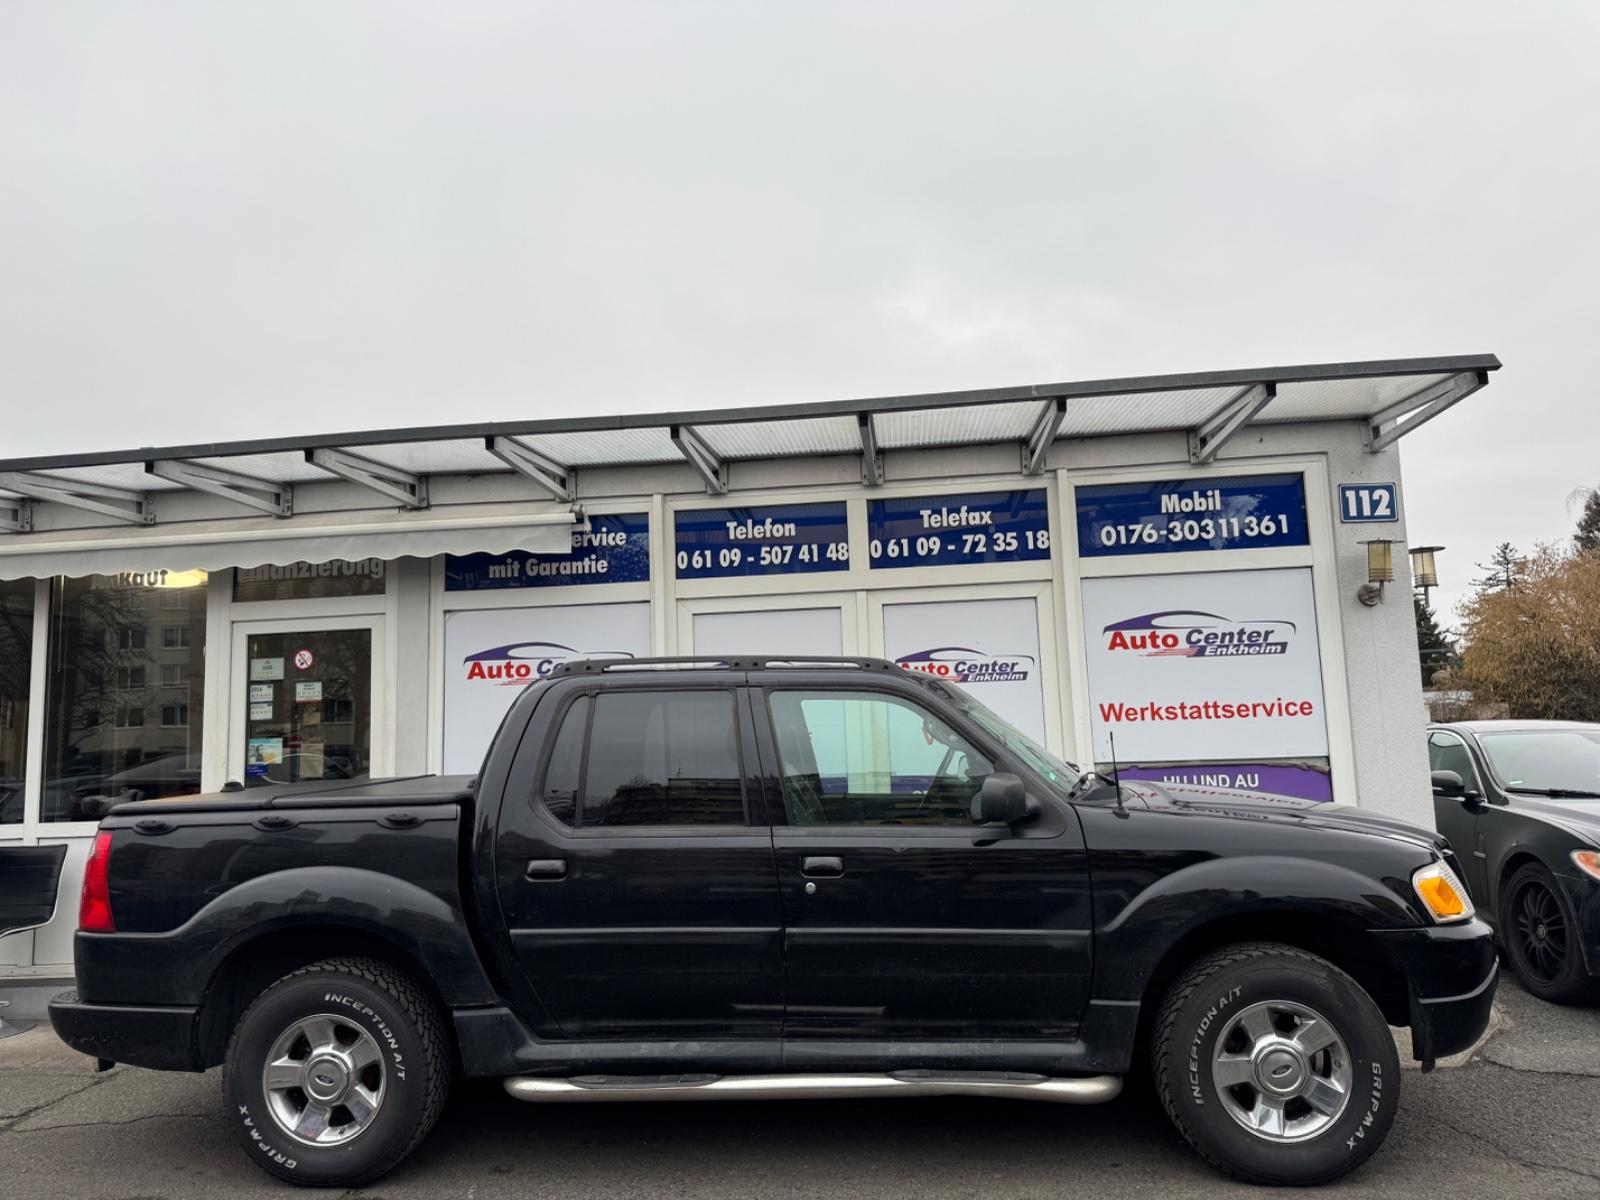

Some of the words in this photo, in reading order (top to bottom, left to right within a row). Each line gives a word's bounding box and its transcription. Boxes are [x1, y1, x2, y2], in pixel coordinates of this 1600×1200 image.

[1161, 489, 1221, 514] Mobil
[1344, 489, 1391, 517] 112
[920, 505, 992, 528] Telefax
[571, 527, 627, 548] ervice
[726, 518, 796, 540] Telefon
[677, 551, 688, 569] 0
[692, 550, 712, 569] 61
[719, 548, 741, 567] 09
[760, 545, 793, 566] 507
[799, 544, 819, 563] 41
[826, 542, 848, 561] 48
[870, 539, 882, 559] 0
[887, 538, 909, 558] 61
[916, 536, 941, 556] 09
[962, 533, 987, 553] 72
[993, 531, 1018, 551] 35
[1025, 530, 1050, 550] 18
[488, 558, 520, 579] mit
[525, 555, 608, 577] Garantie
[1108, 629, 1179, 651] Auto
[1185, 626, 1275, 646] Center
[1204, 643, 1282, 657] Enkheim
[466, 660, 531, 680] Auto
[954, 660, 1019, 674] Center
[968, 672, 1024, 682] Enkheim
[1099, 697, 1314, 723] Werkstattservice
[1193, 774, 1230, 788] UND
[1235, 773, 1259, 788] AU
[324, 993, 399, 1049] INCEPTION
[392, 1052, 406, 1081] A/T
[1189, 1008, 1218, 1105] INCEPTION
[1219, 985, 1243, 1010] A/T
